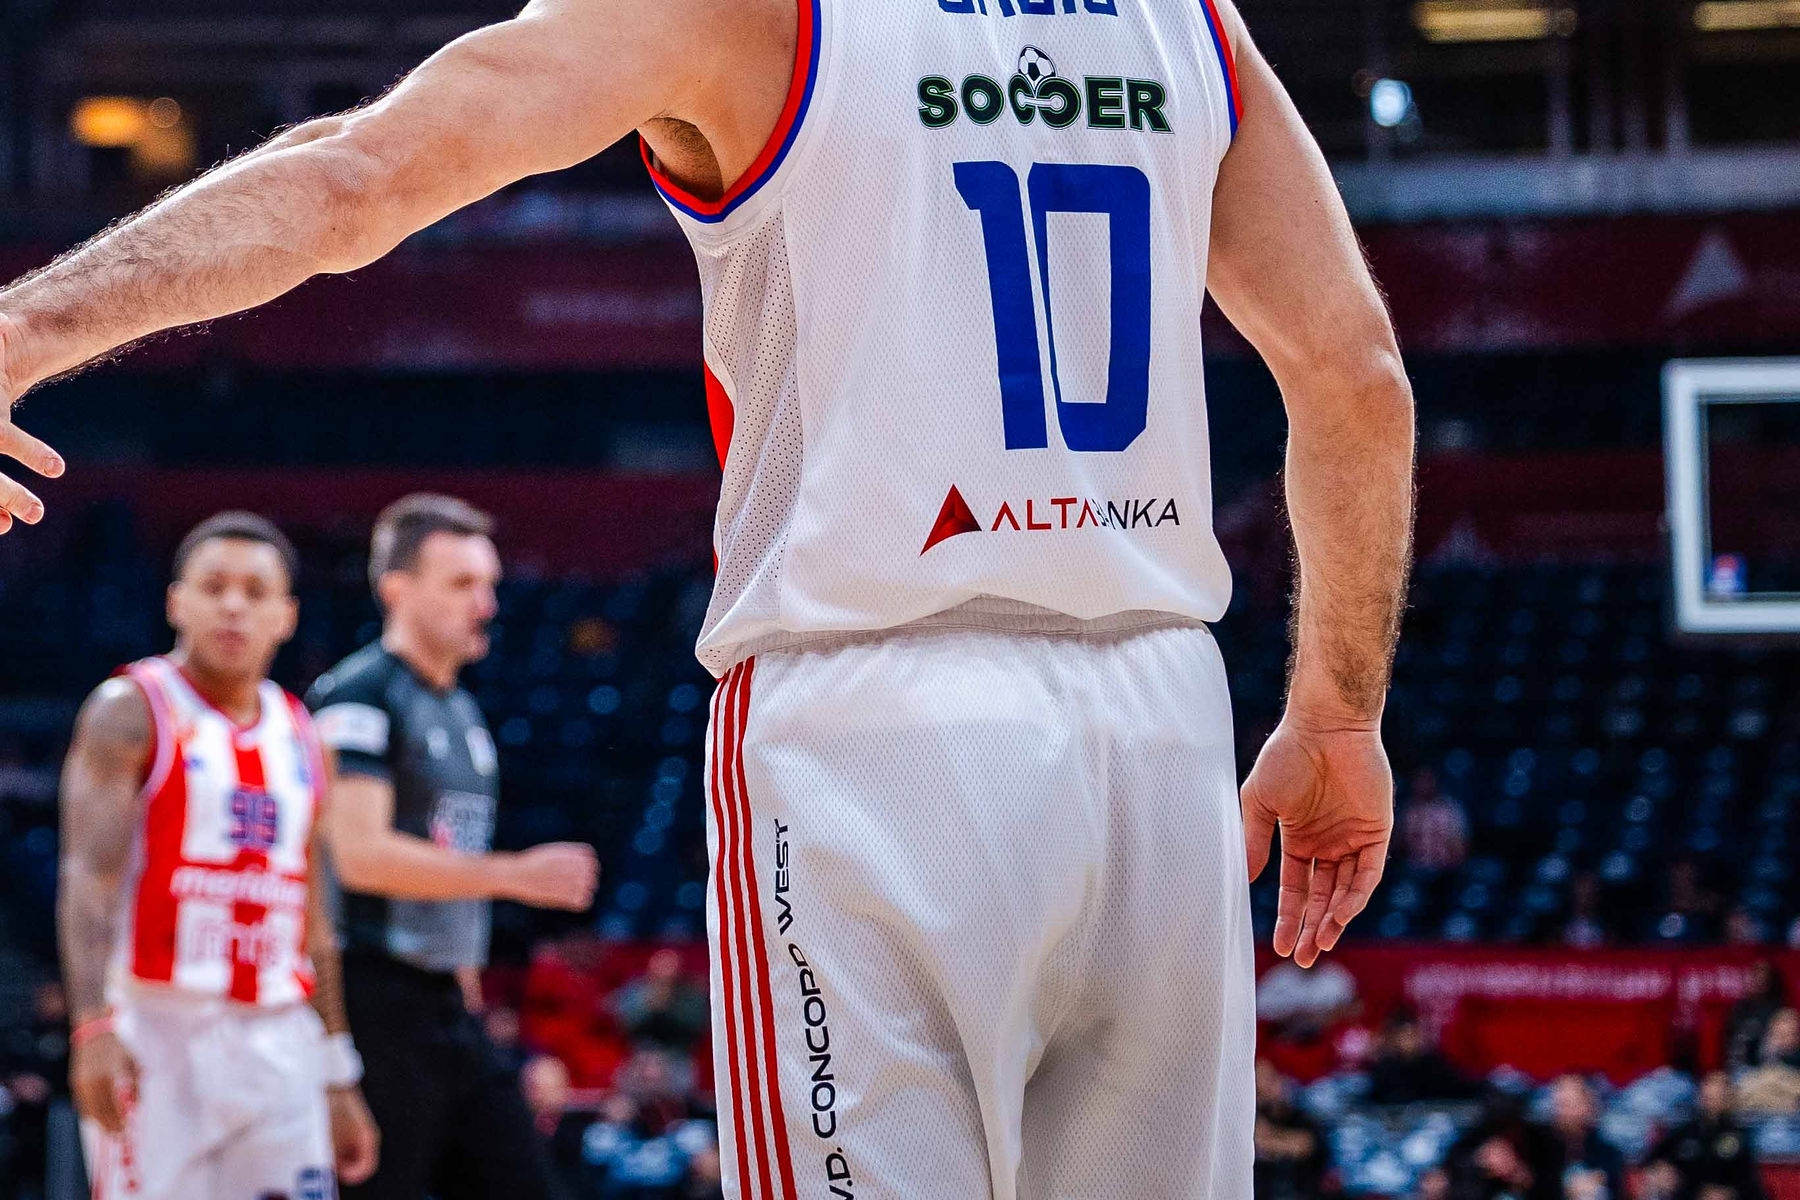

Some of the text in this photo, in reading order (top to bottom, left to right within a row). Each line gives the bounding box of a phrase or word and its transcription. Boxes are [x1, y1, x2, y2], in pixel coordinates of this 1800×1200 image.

[917, 73, 1174, 134] SOCCER
[953, 160, 1151, 452] 10
[990, 497, 1181, 531] ALTANKA
[774, 818, 794, 936] WEST
[788, 943, 836, 1139] CONCORD
